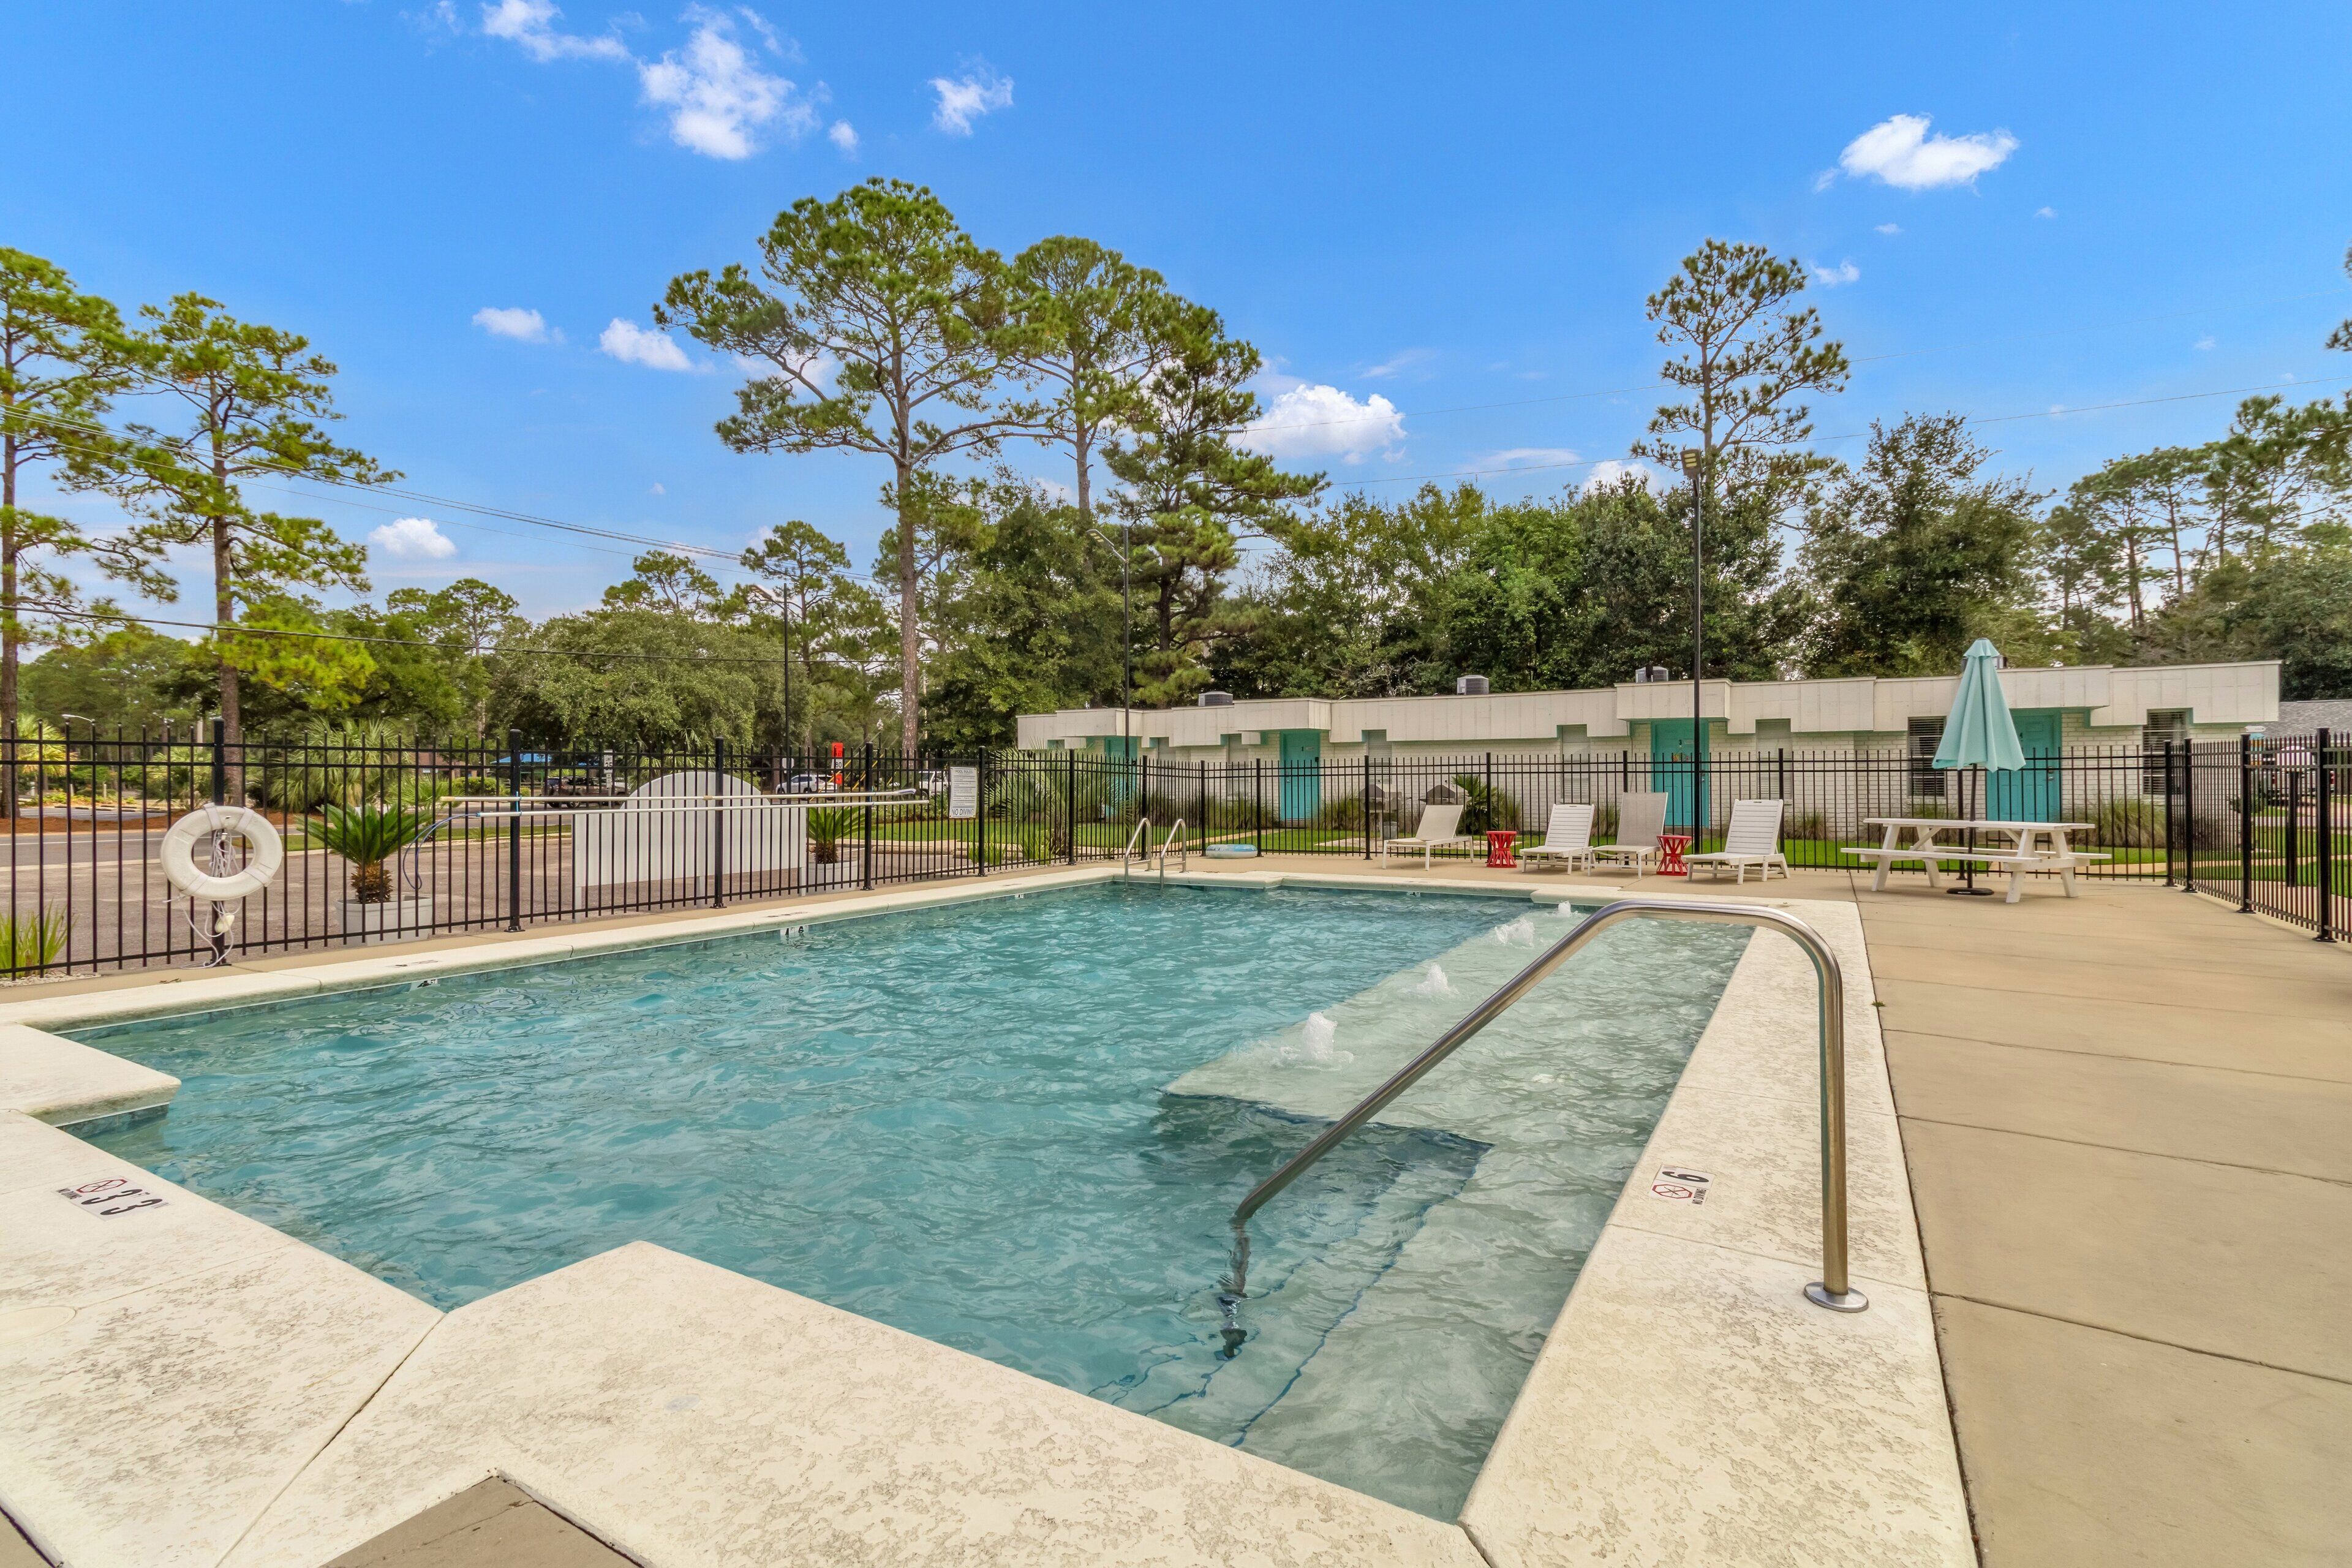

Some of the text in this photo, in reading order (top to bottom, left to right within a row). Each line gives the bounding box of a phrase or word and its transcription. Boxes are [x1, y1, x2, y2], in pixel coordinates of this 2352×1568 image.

[1662, 1171, 1709, 1182] 6
[61, 1191, 82, 1200] DIVING
[81, 1189, 143, 1205] 3
[1694, 1188, 1707, 1199] DIVING
[100, 1199, 163, 1215] 3
